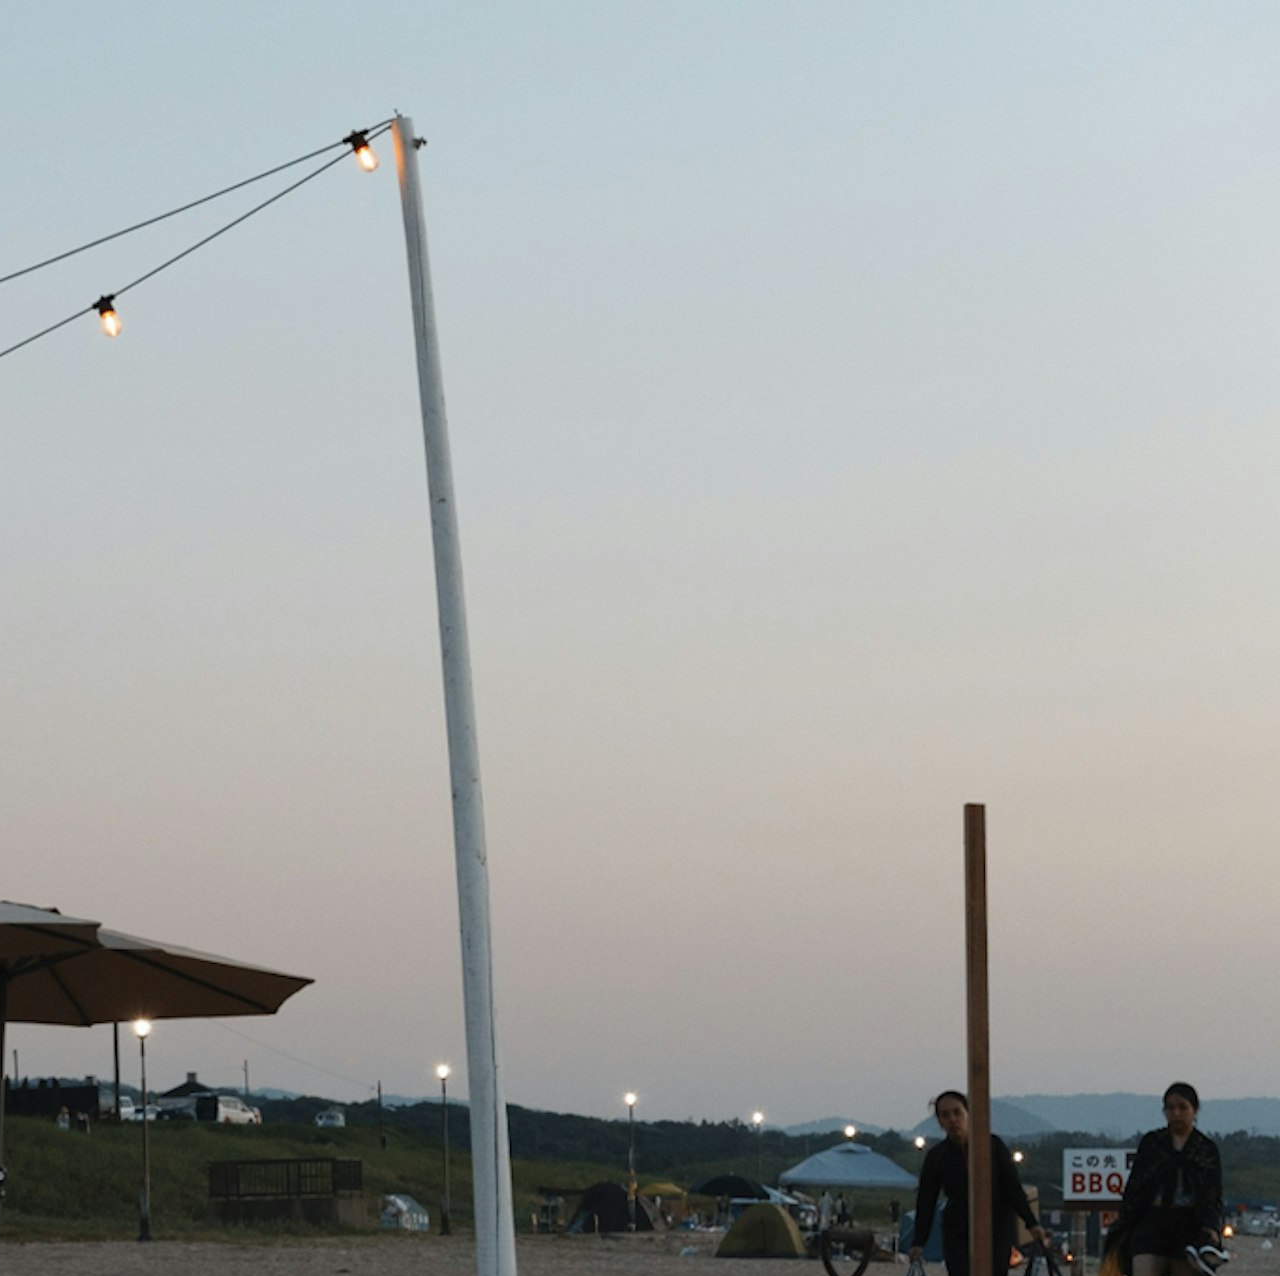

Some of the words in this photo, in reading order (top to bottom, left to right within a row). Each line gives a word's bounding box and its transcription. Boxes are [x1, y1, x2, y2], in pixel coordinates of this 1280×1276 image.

[1071, 1154, 1117, 1168] この先
[1071, 1172, 1124, 1195] BBQ
